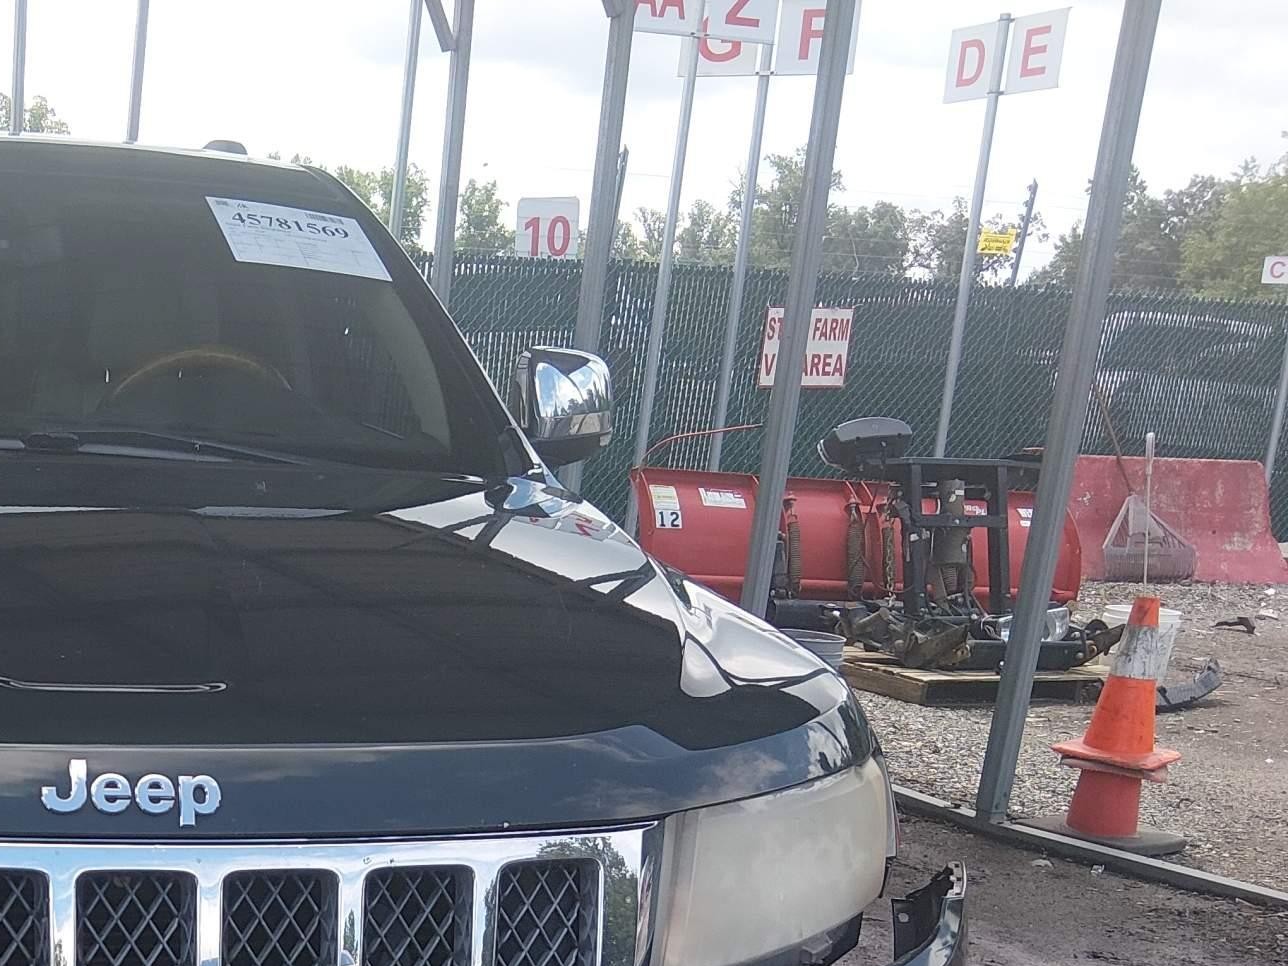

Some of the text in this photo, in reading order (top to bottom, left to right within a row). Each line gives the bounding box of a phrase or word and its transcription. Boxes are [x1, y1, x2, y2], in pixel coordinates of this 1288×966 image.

[955, 38, 986, 88] D
[1020, 25, 1052, 79] E
[232, 212, 349, 239] 45781569
[524, 215, 571, 257] 10
[1270, 261, 1286, 279] C
[813, 318, 851, 341] FARM
[658, 511, 680, 528] 12
[41, 758, 222, 828] Jeep
